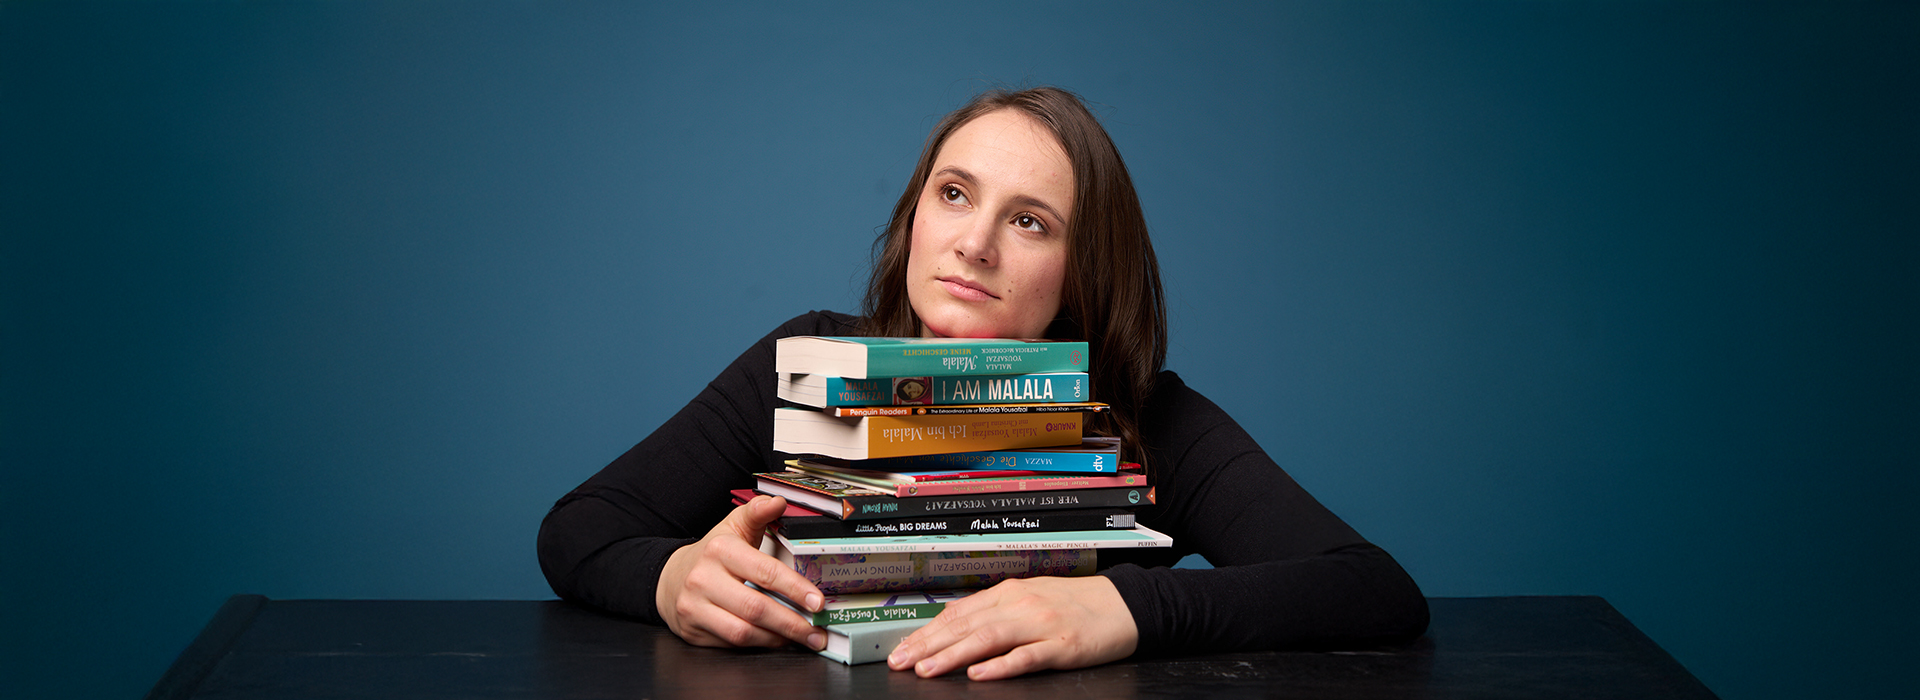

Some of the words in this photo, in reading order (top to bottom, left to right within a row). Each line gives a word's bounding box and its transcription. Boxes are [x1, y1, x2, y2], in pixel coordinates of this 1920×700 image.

[942, 355, 979, 372] Malala
[845, 381, 878, 391] MALALA
[942, 380, 946, 401] I
[952, 379, 981, 401] AM
[988, 378, 1053, 400] MALALA
[838, 391, 885, 401] YOUSAFZAI
[850, 408, 878, 416] Penguin
[971, 421, 990, 429] Lamb
[1052, 422, 1076, 431] KNAUR
[883, 426, 923, 443] Malala
[927, 425, 945, 440] bin
[949, 424, 967, 438] Ich
[971, 428, 1010, 440] Yousafzai
[1012, 427, 1038, 437] Malala
[940, 453, 996, 467] Geschichte
[1000, 456, 1017, 467] Die
[1025, 457, 1053, 465] MAZZA
[1093, 455, 1103, 472] dtv
[991, 498, 1035, 507] MALALA
[1040, 497, 1054, 506] IST
[1058, 496, 1079, 504] WER
[862, 503, 881, 514] BROWN
[882, 503, 898, 512] DINAH
[925, 501, 987, 511] YOUSAFZAI?
[855, 524, 874, 533] Little
[875, 524, 898, 534] People,
[900, 523, 913, 531] BIG
[915, 522, 947, 531] DREAMS
[970, 519, 999, 531] Malala
[1002, 517, 1040, 529] Yousafzai
[933, 561, 987, 572] YOUSAFZAI
[989, 560, 1026, 569] MALALA
[1051, 558, 1088, 568] DROEMER
[829, 567, 851, 577] WAY
[853, 566, 868, 575] MY
[869, 564, 911, 574] FINDING
[829, 608, 880, 622] Yousafzai
[883, 607, 917, 618] Malala
